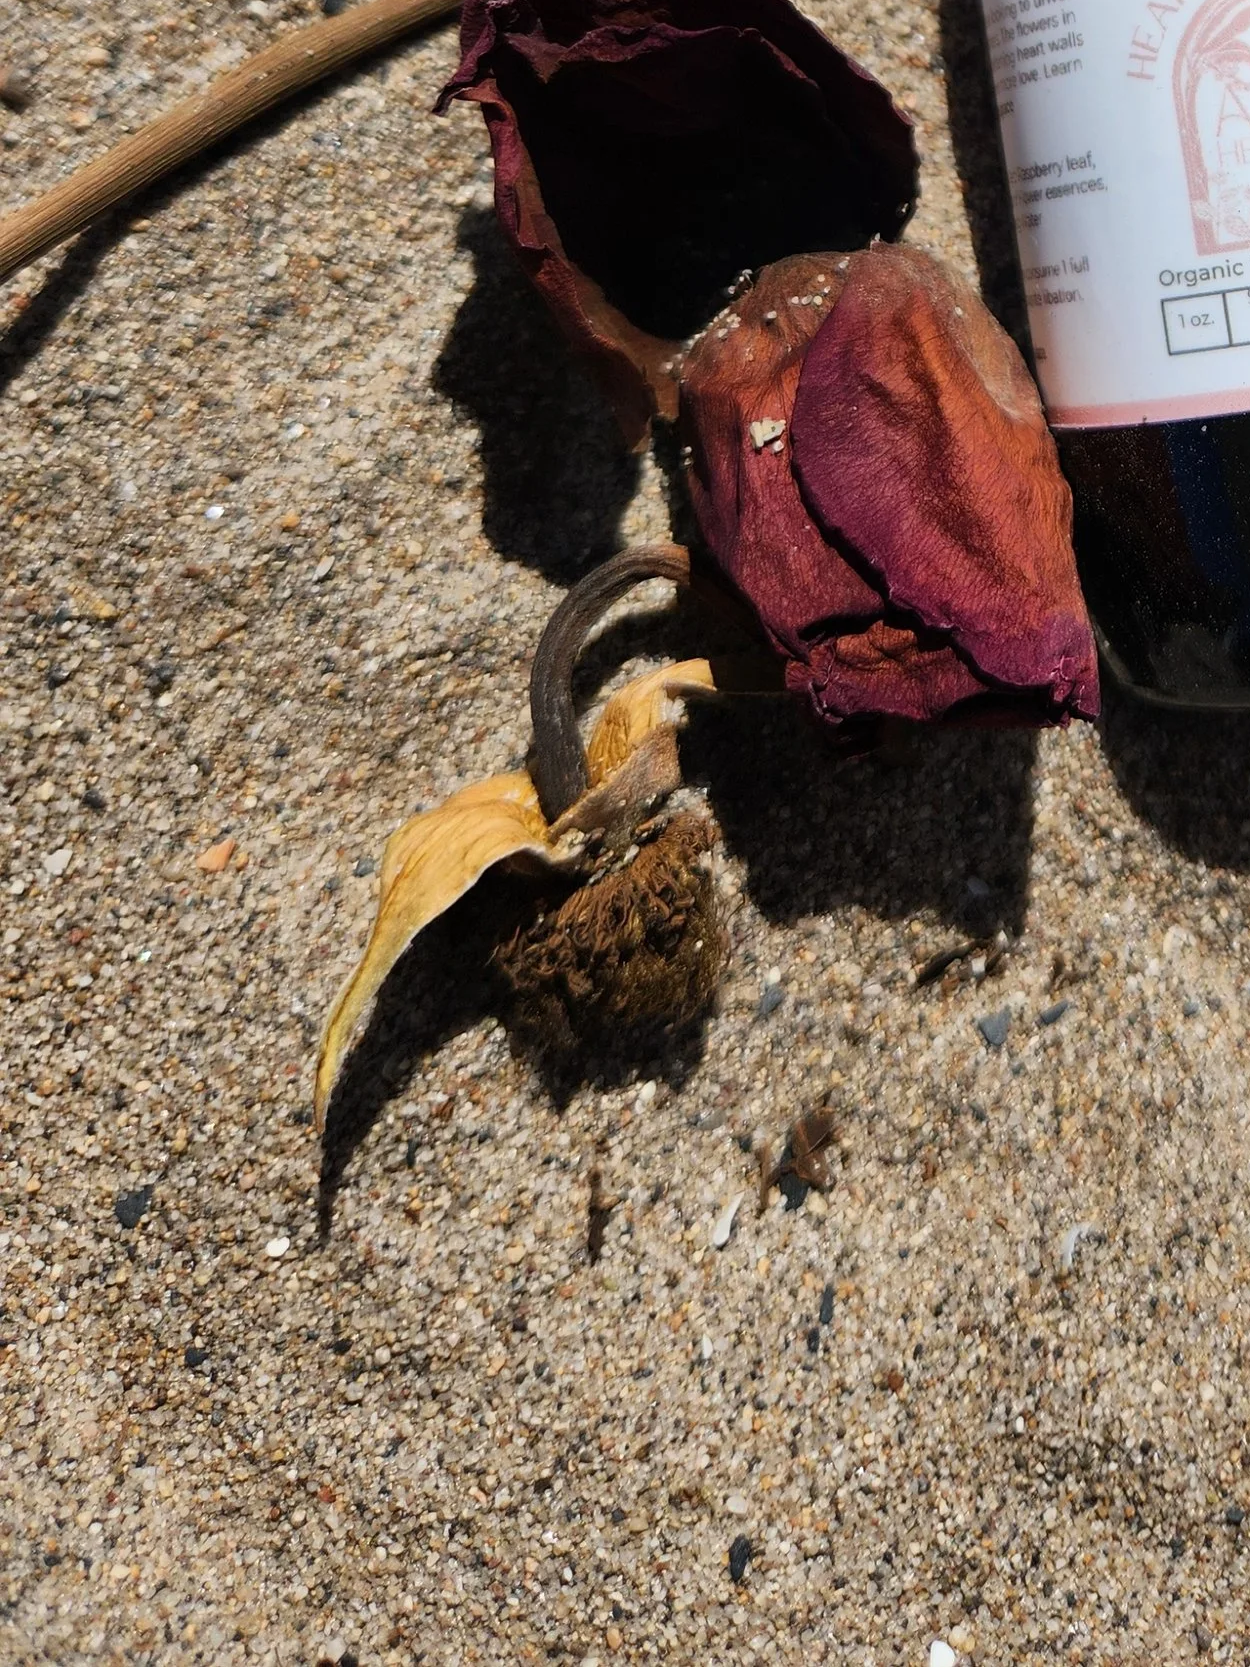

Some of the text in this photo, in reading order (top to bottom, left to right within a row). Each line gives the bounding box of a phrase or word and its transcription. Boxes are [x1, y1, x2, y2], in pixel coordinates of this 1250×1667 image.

[1018, 0, 1031, 13] to
[1016, 14, 1059, 37] flowers
[1061, 8, 1076, 25] in
[1016, 41, 1046, 61] heart
[1048, 31, 1084, 52] walls
[1043, 58, 1083, 79] Learn
[1066, 150, 1096, 171] leaf,
[1045, 177, 1108, 200] essences,
[1069, 255, 1090, 274] full
[1158, 259, 1244, 287] Organic
[1178, 311, 1216, 328] 1 oz.
